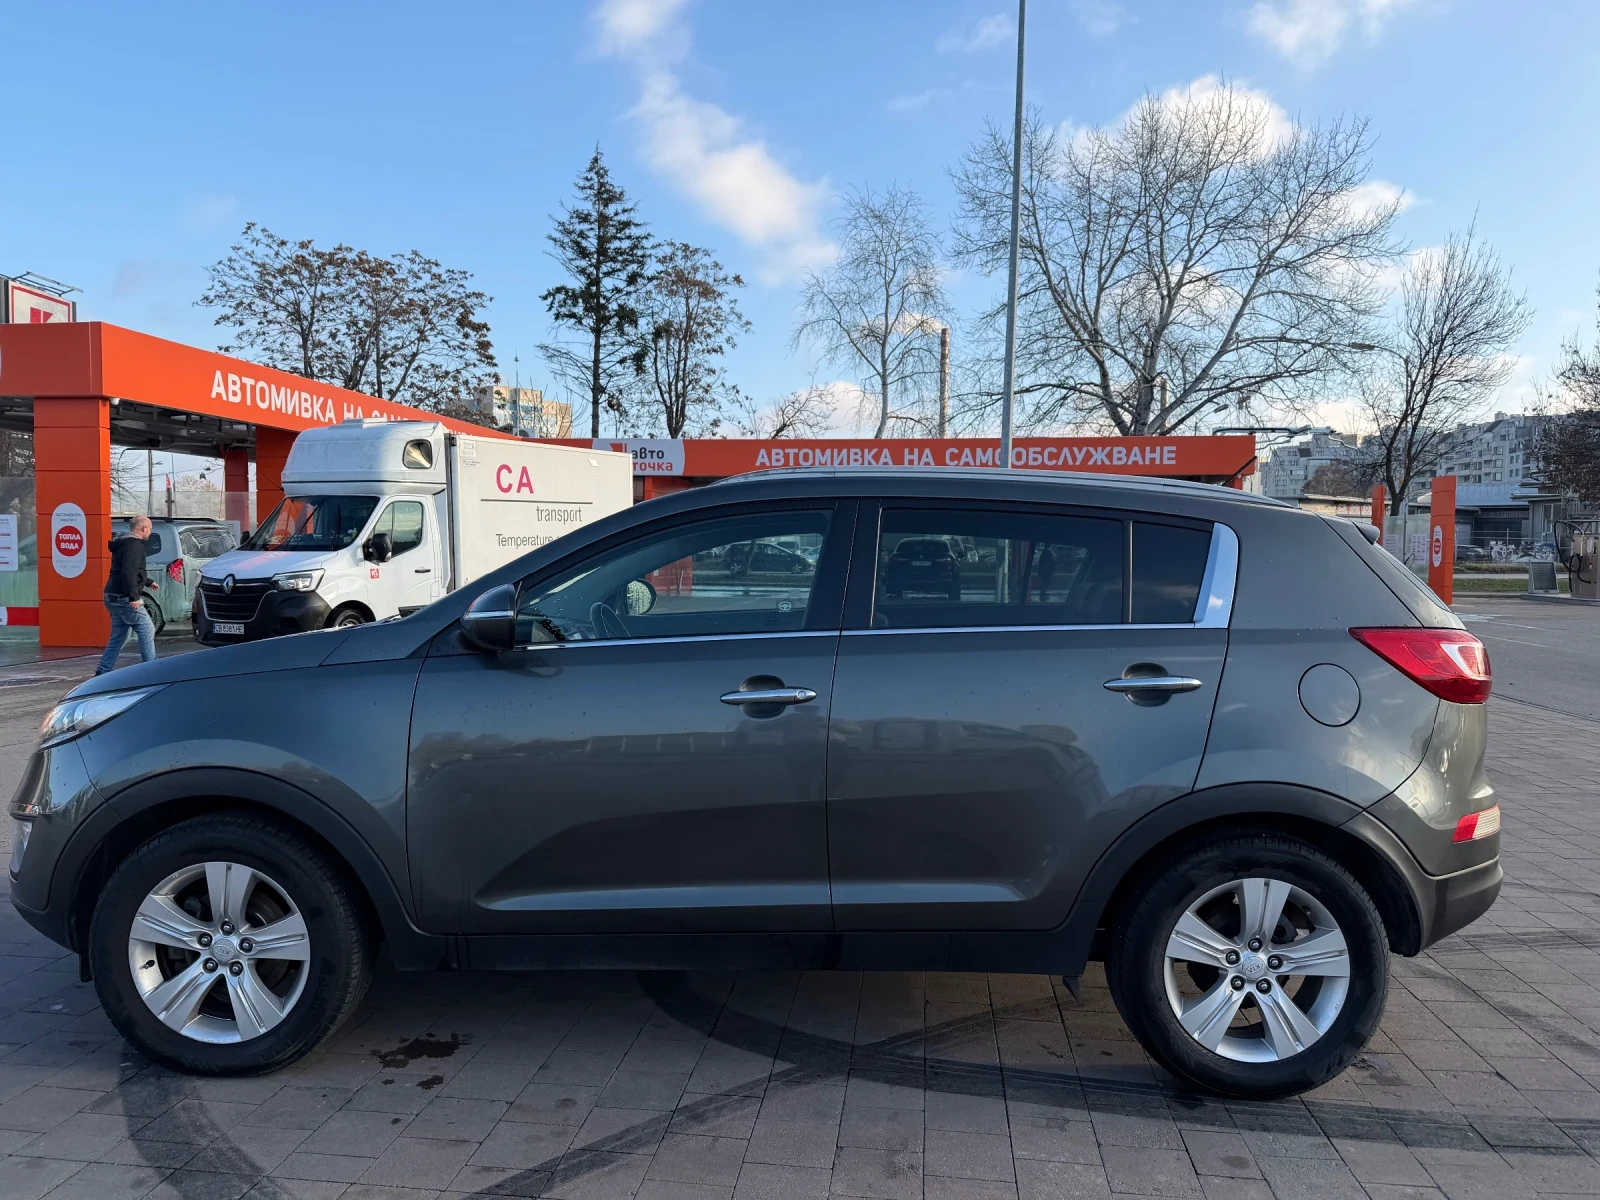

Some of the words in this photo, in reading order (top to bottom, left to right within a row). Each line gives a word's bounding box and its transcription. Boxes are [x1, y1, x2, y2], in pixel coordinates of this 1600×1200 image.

[211, 370, 336, 425] АВТОМИВКА
[343, 402, 364, 420] НА
[631, 446, 665, 460] авто
[755, 448, 893, 466] АВТОМИВКА
[903, 448, 935, 466] НА
[633, 461, 674, 472] точка
[496, 463, 534, 494] CA
[536, 505, 583, 525] transport
[58, 533, 81, 541] ТОПЛА
[496, 533, 554, 549] Temperature
[60, 542, 80, 550] ВОДА
